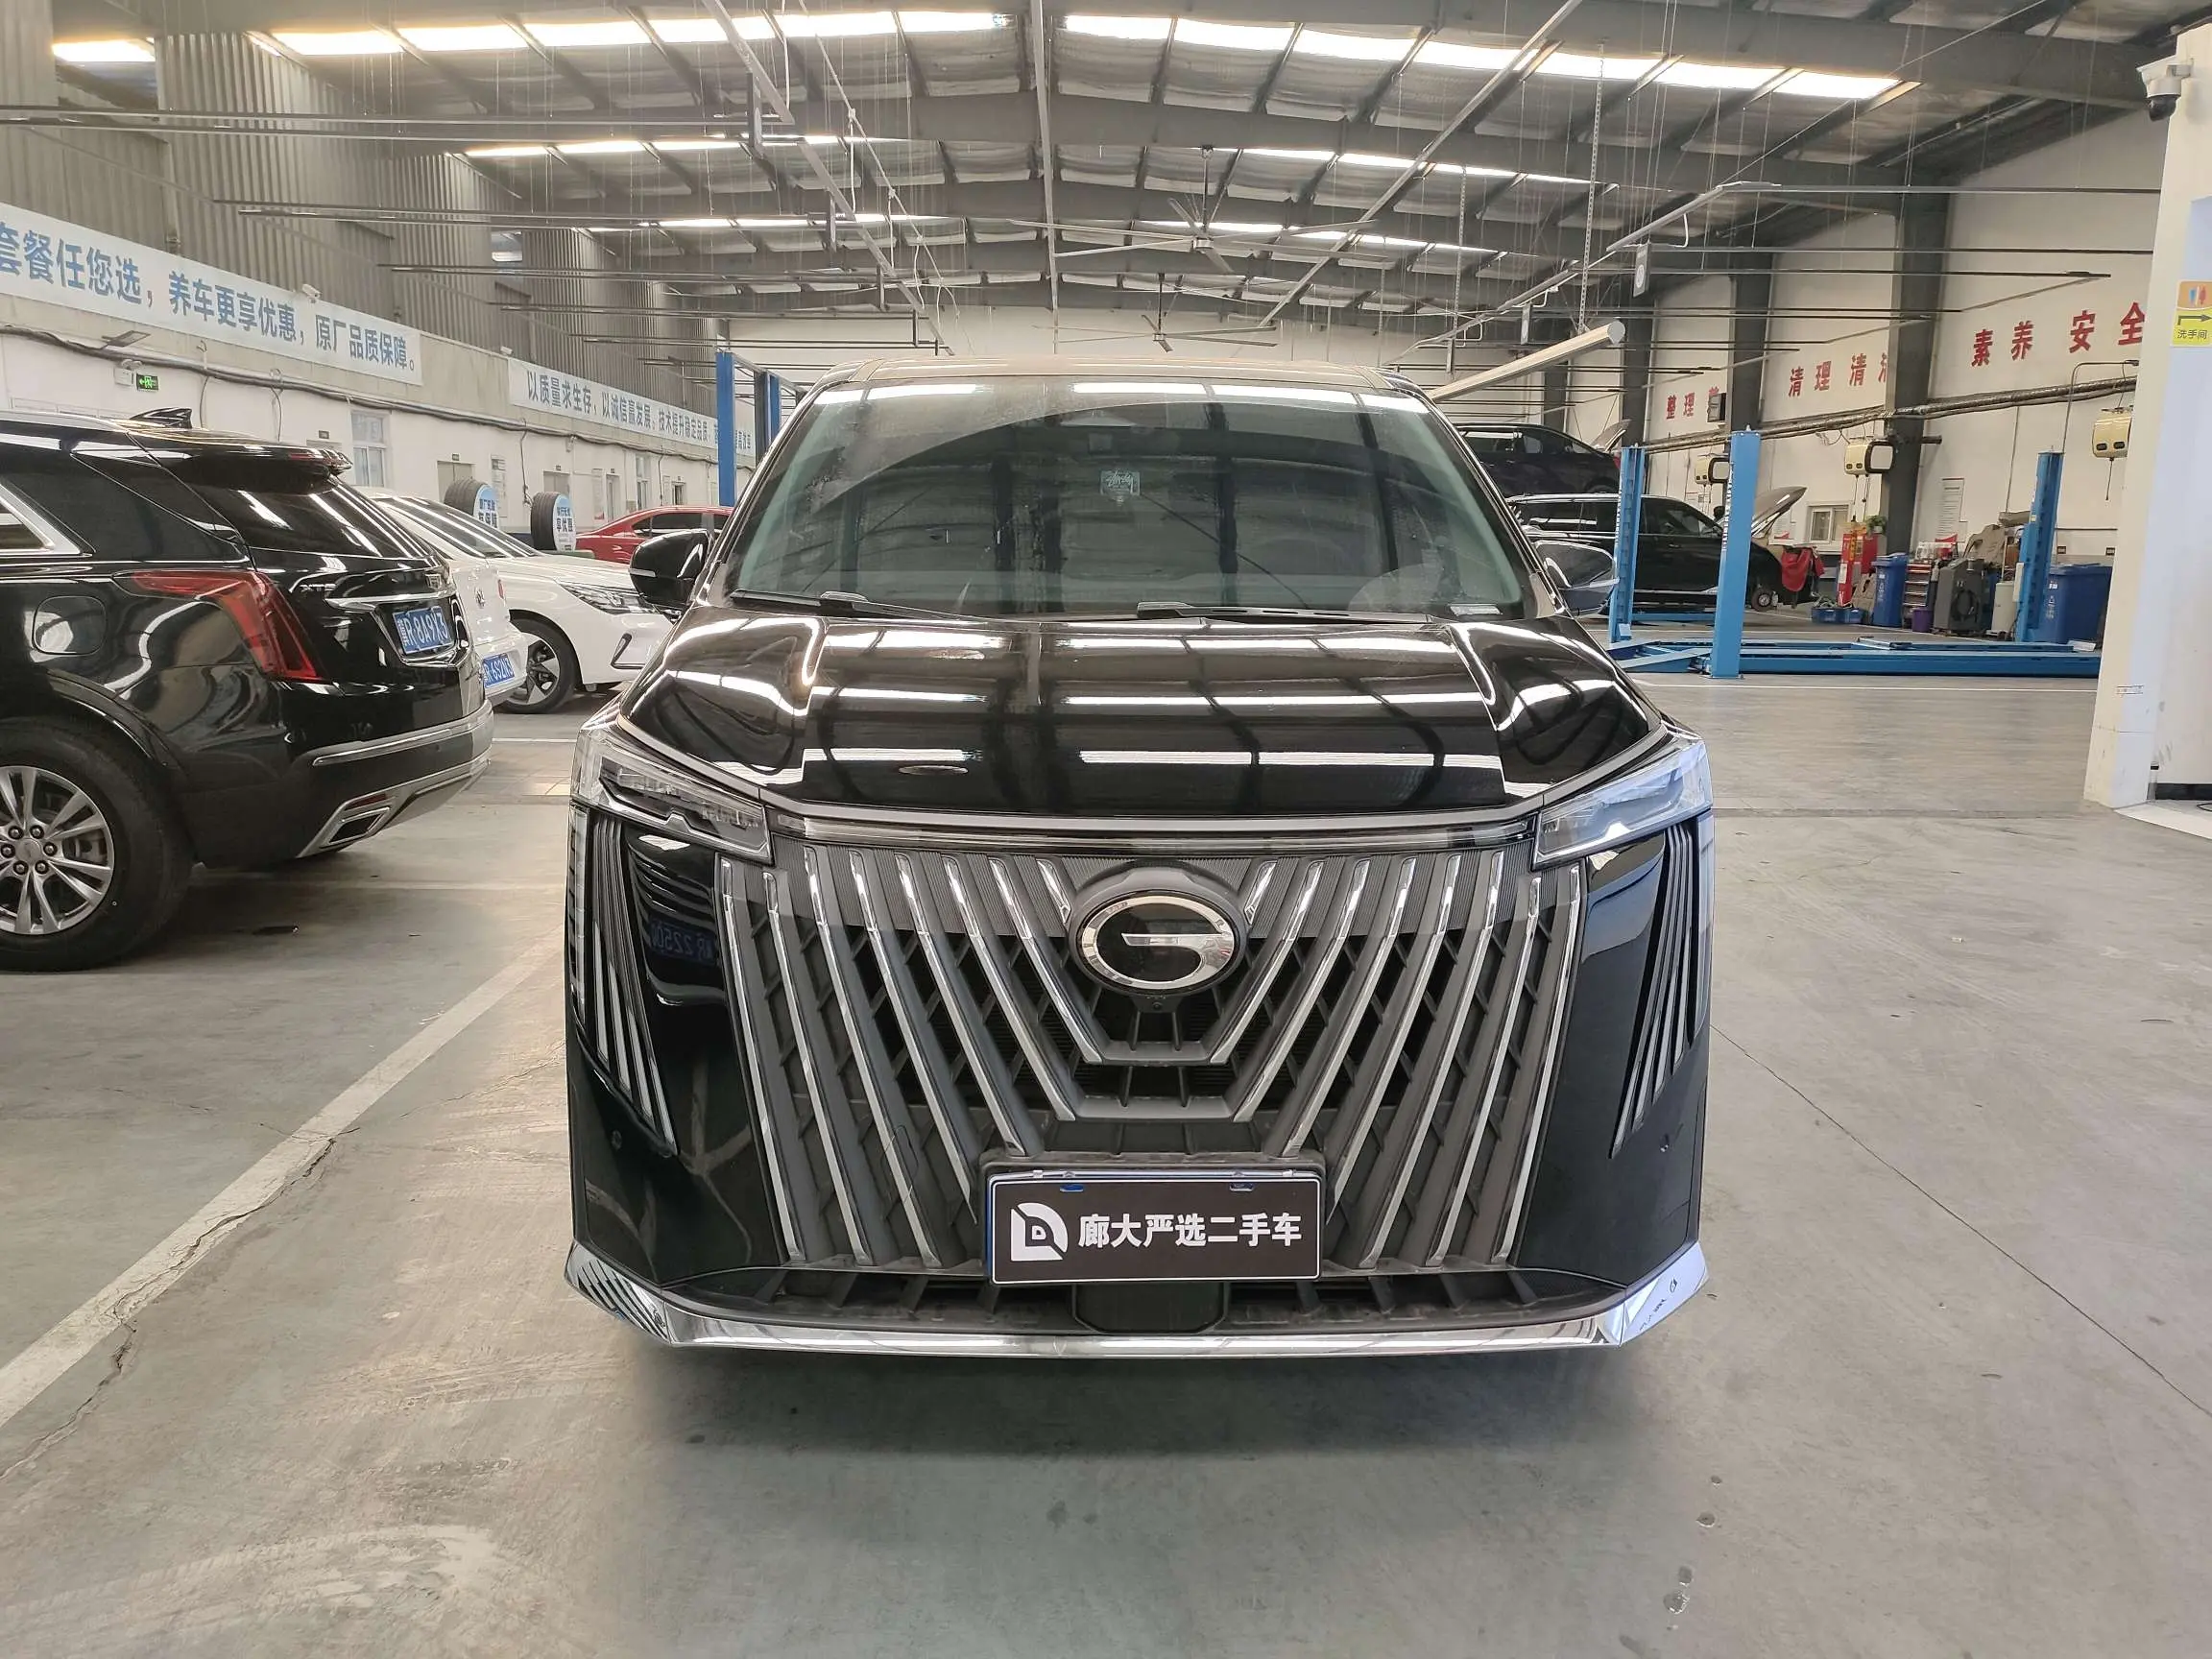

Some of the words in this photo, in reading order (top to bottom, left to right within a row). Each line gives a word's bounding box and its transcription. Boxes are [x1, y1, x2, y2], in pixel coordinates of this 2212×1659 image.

[2176, 328, 2208, 340] 洗手间
[1078, 1213, 1302, 1248] 廊大严选二手车
